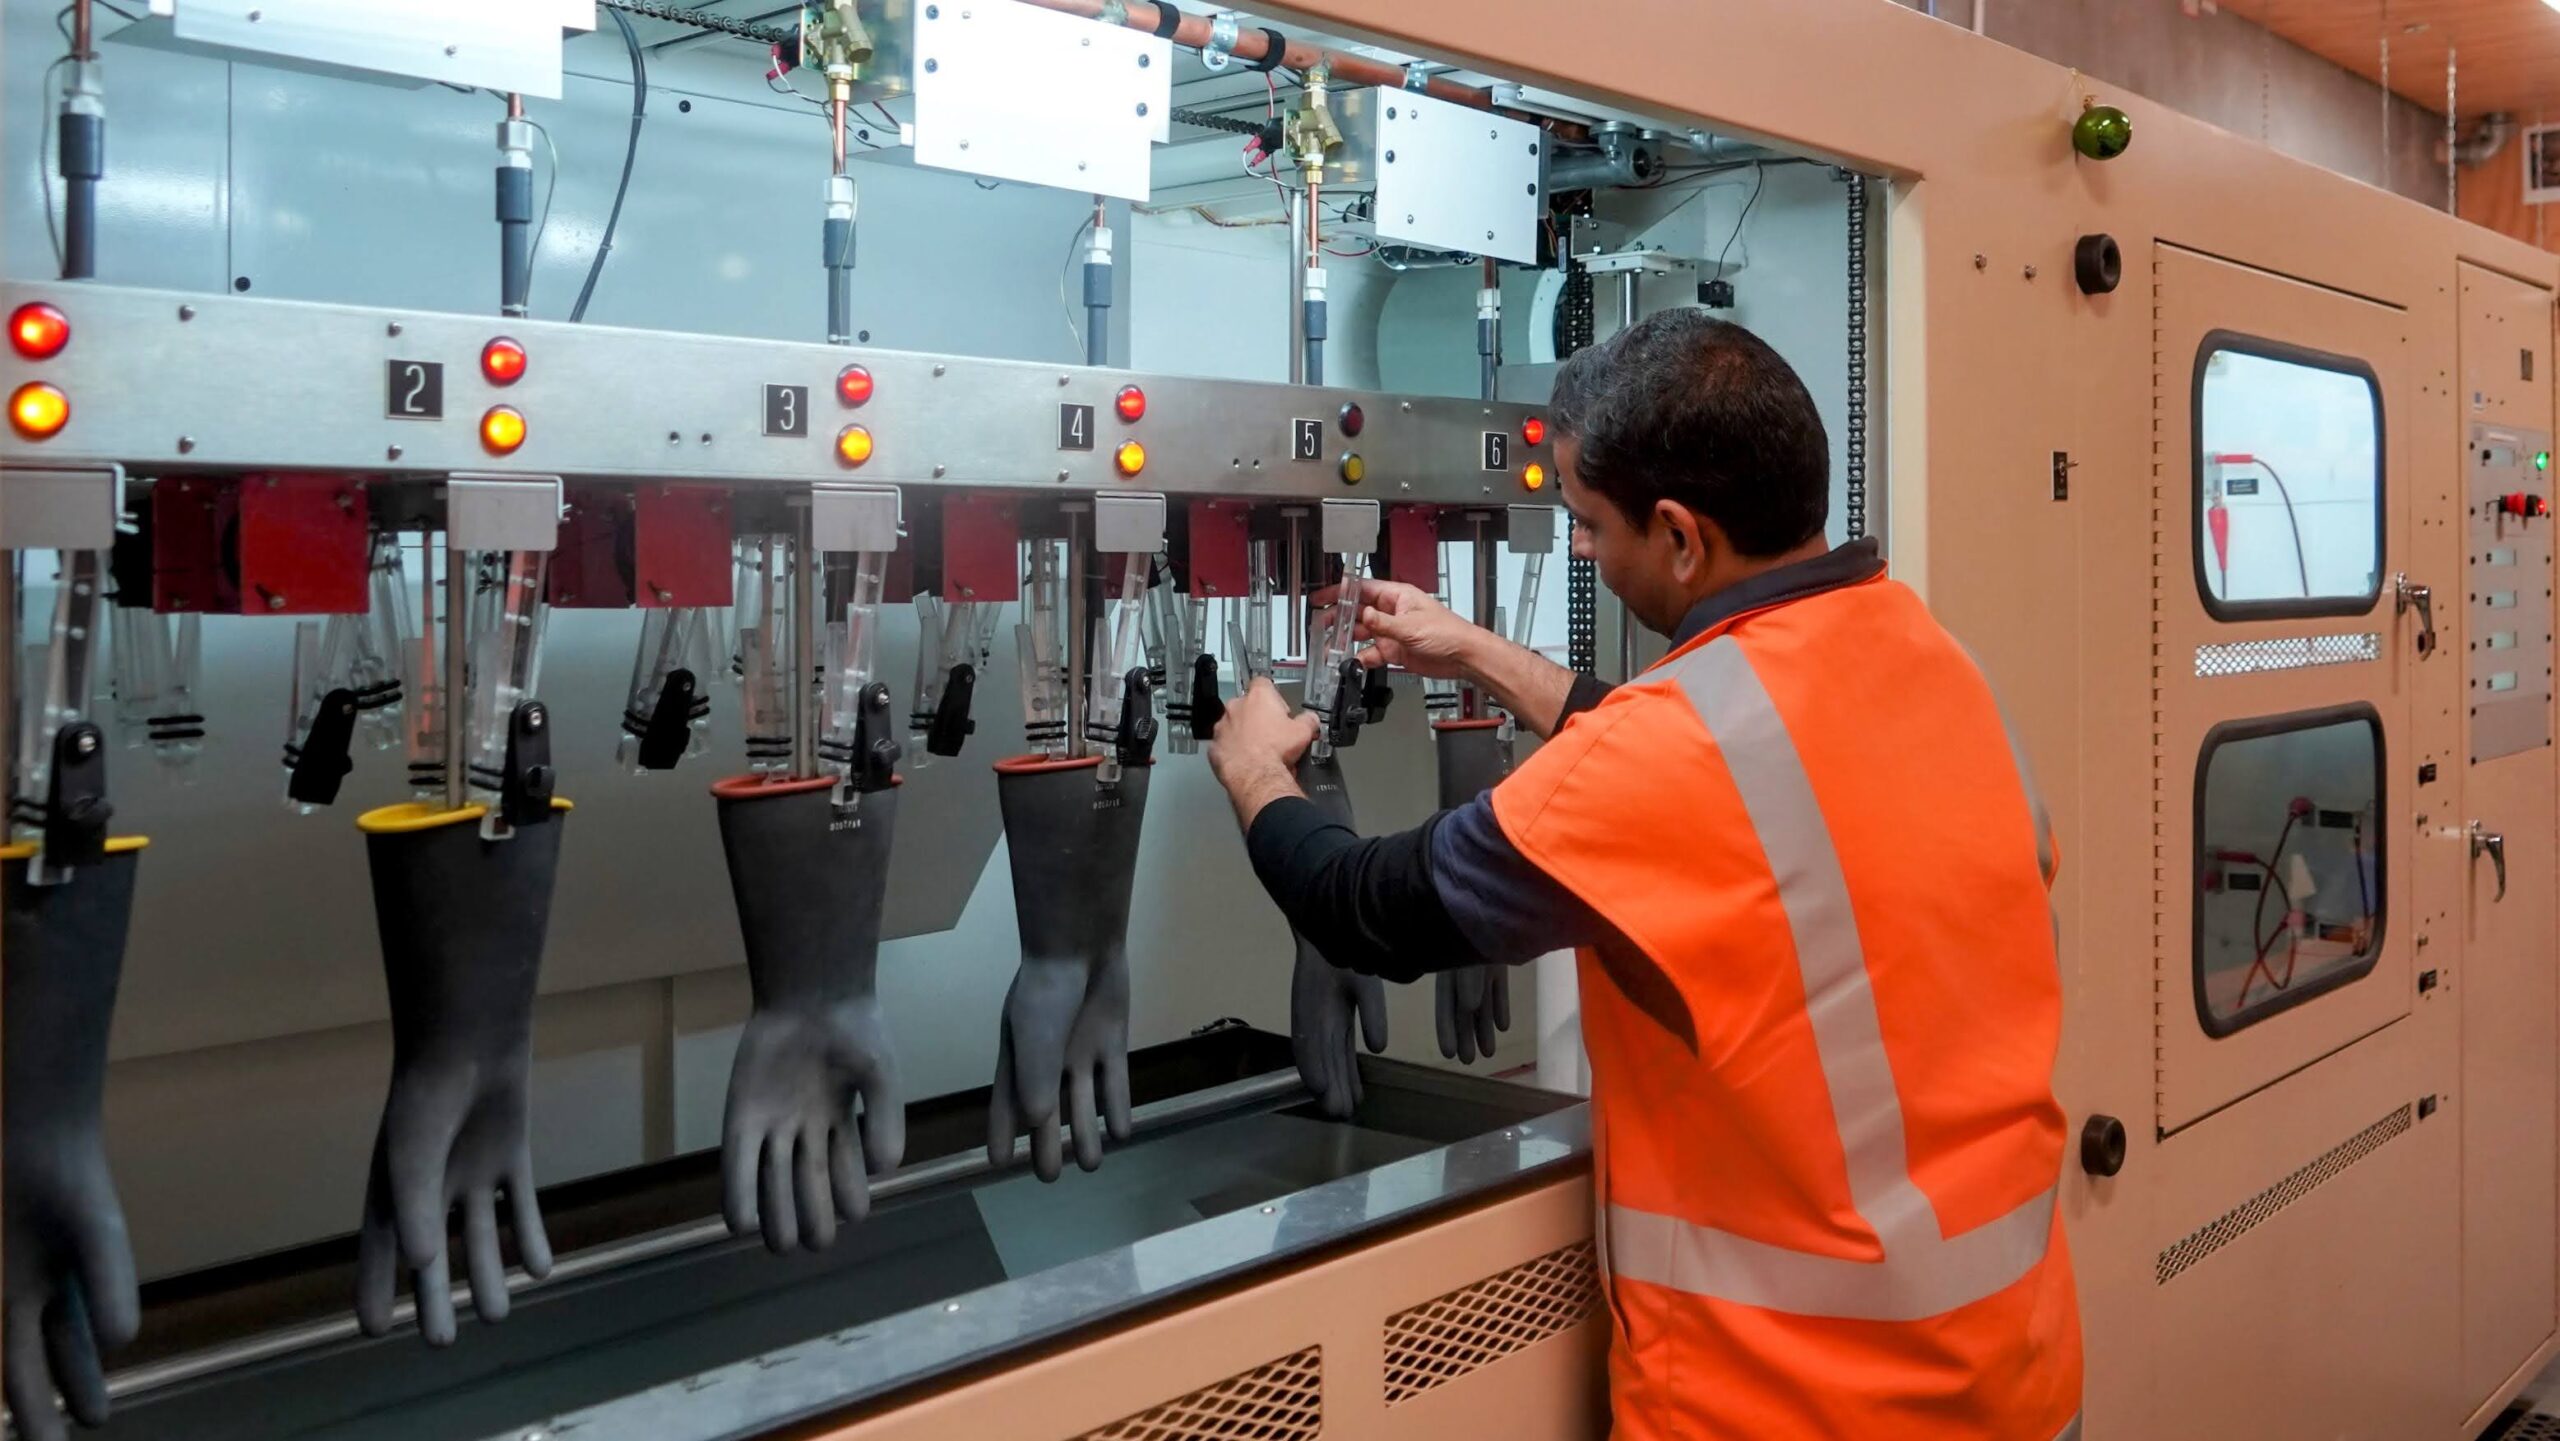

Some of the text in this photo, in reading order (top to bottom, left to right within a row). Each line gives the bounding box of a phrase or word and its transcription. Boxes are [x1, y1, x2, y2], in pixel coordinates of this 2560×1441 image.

[406, 364, 426, 412] 2
[780, 388, 795, 430] 3
[1071, 407, 1083, 445] 4
[1304, 422, 1315, 457] 5
[1492, 436, 1501, 466] 6
